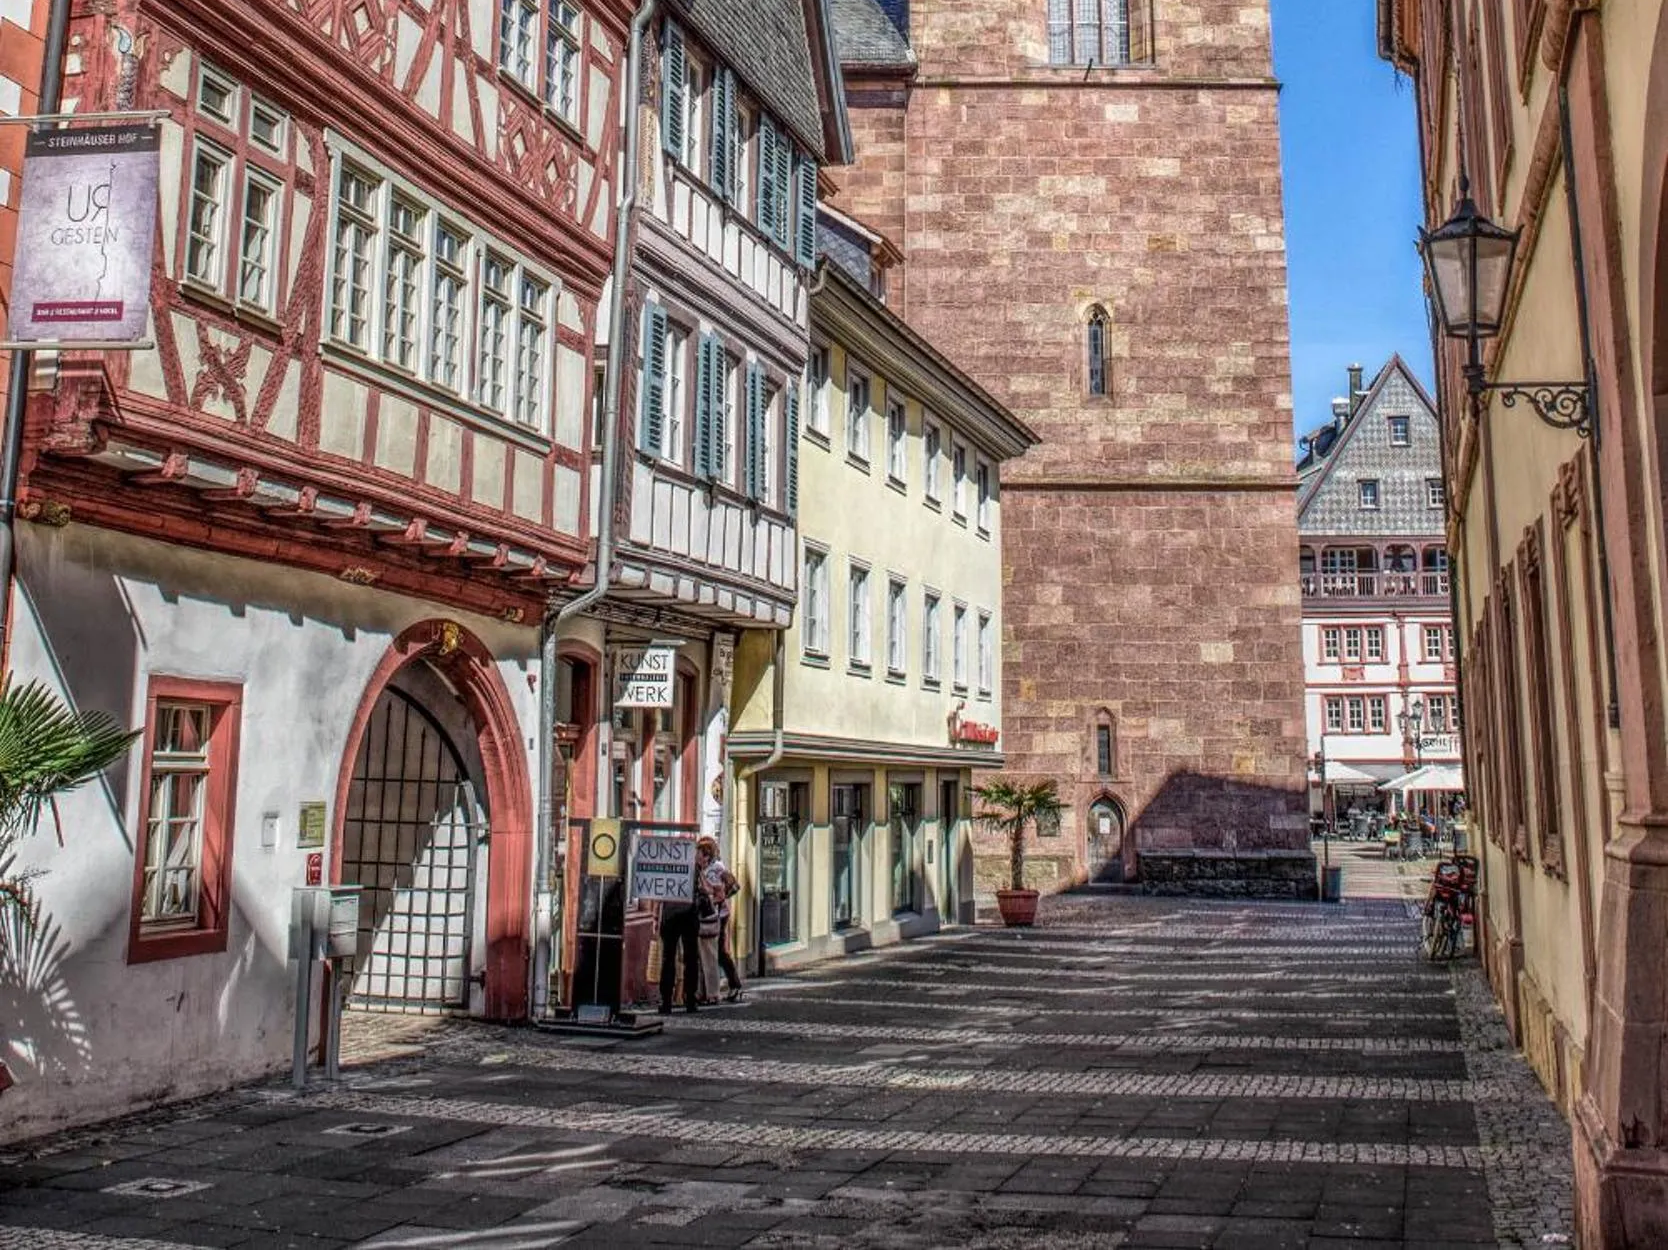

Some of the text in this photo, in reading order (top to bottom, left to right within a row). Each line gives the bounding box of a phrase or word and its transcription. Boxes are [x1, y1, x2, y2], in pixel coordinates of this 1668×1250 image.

[47, 133, 139, 148] STEINHÄUSER HOF
[620, 653, 669, 670] KUNST
[638, 841, 691, 860] KUNST
[635, 876, 689, 898] WERK
